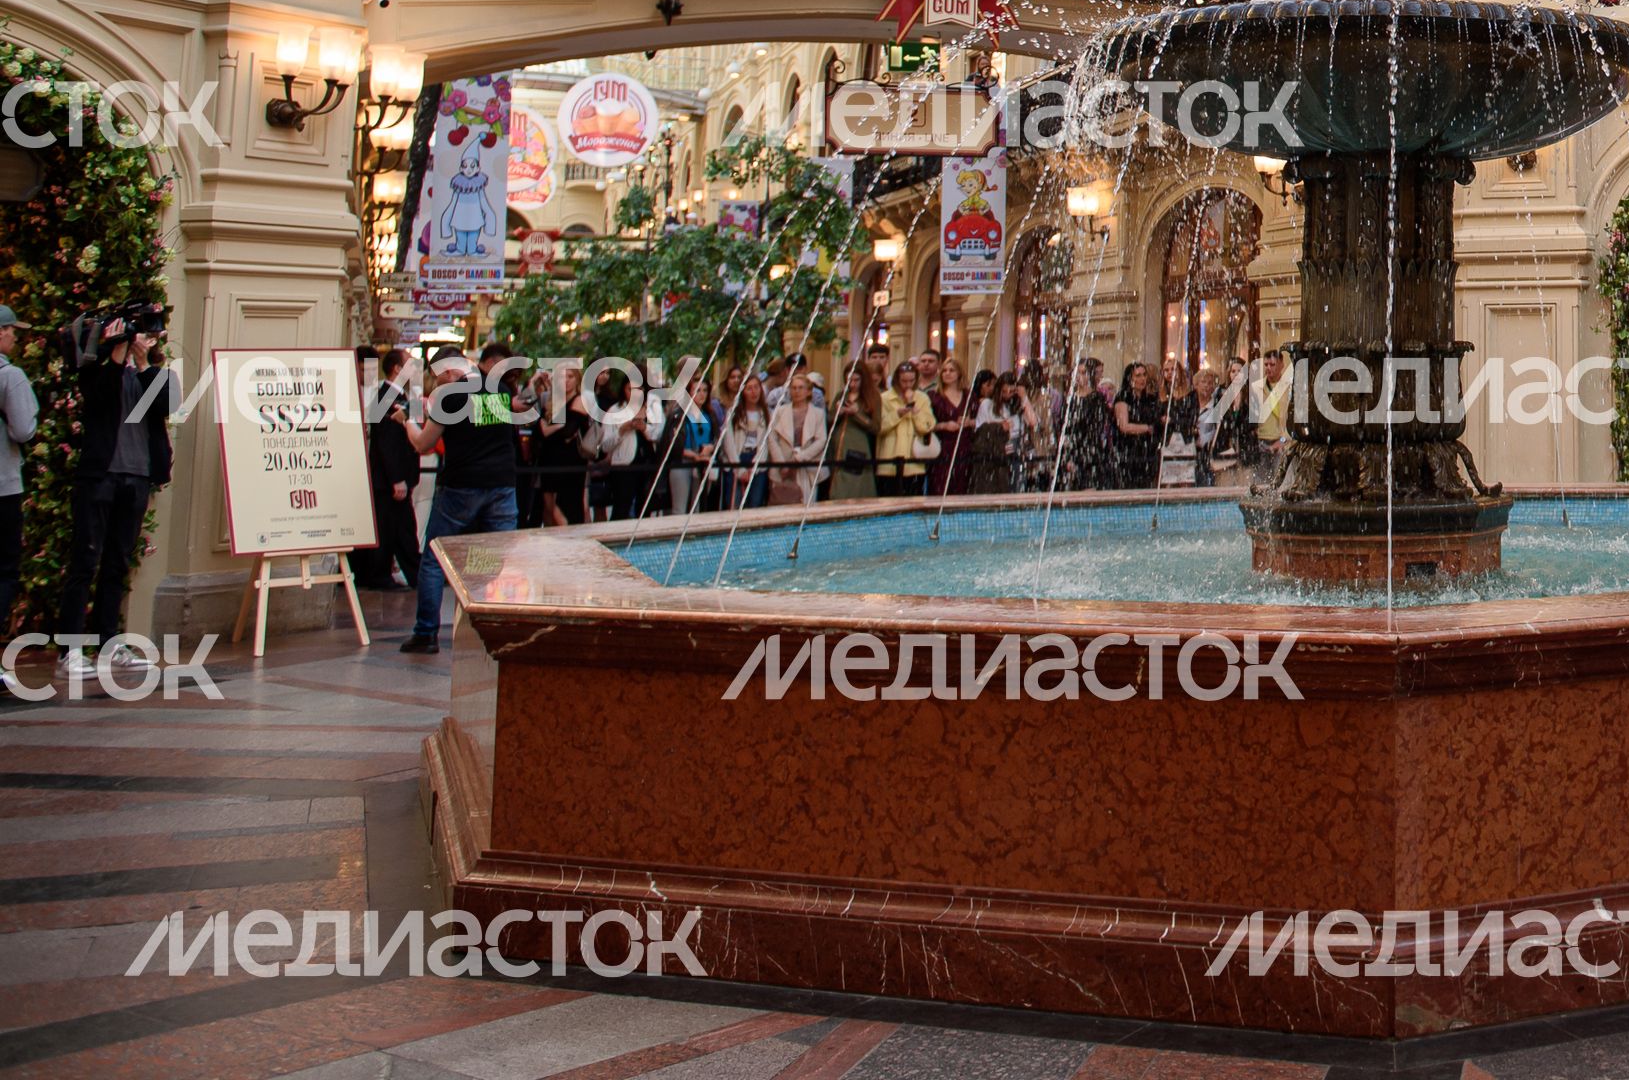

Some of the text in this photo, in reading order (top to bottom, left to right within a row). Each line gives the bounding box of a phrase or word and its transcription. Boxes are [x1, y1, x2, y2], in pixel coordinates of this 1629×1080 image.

[593, 79, 629, 103] ГУМ
[256, 380, 324, 397] БОЛЬШОЙ
[259, 403, 329, 434] SS22
[262, 436, 329, 449] ПОНЕДЕЛЬНИК
[263, 449, 333, 472] 20.06.22
[288, 473, 313, 486] 17-30
[289, 489, 318, 510] ГУМ
